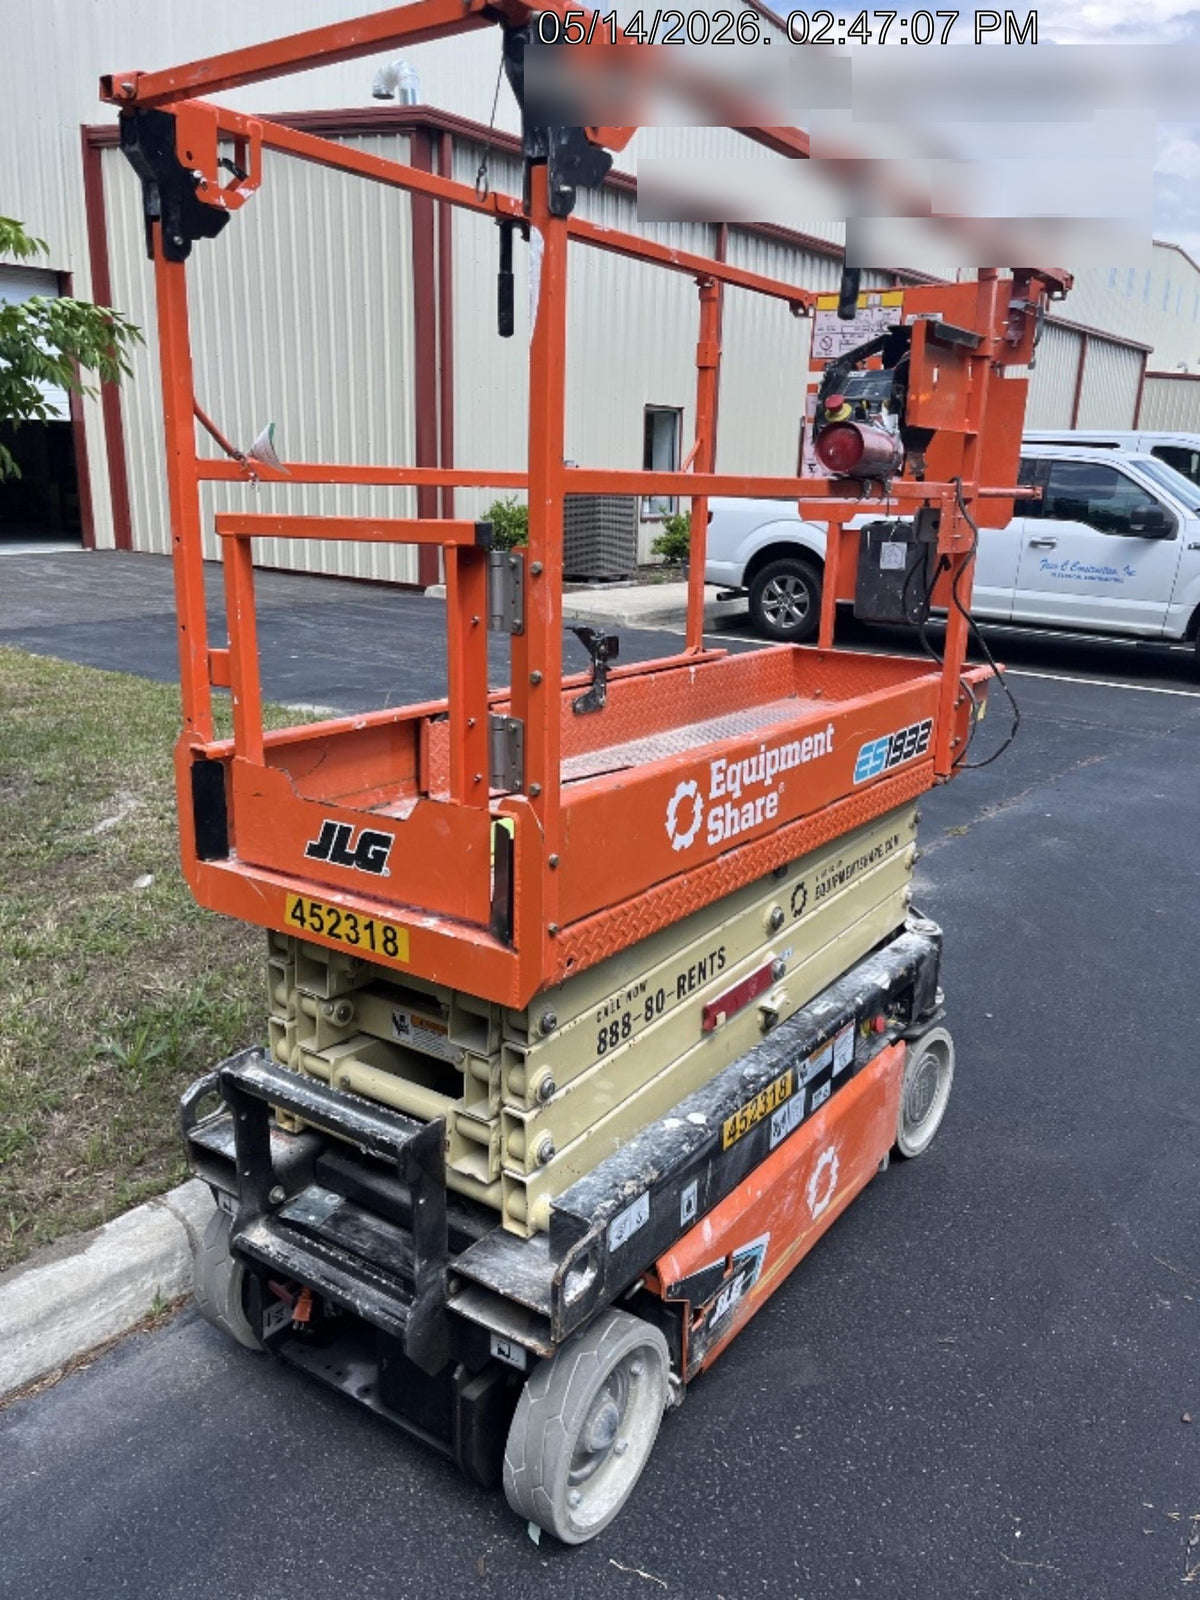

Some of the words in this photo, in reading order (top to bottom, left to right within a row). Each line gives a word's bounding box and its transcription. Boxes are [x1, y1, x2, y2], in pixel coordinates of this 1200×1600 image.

[709, 723, 835, 800] Equipment
[853, 717, 934, 785] ES1932
[290, 897, 399, 957] 452318
[596, 945, 727, 1055] 888-80-RENTS
[626, 979, 648, 1002] NOW
[726, 1074, 788, 1140] 452318
